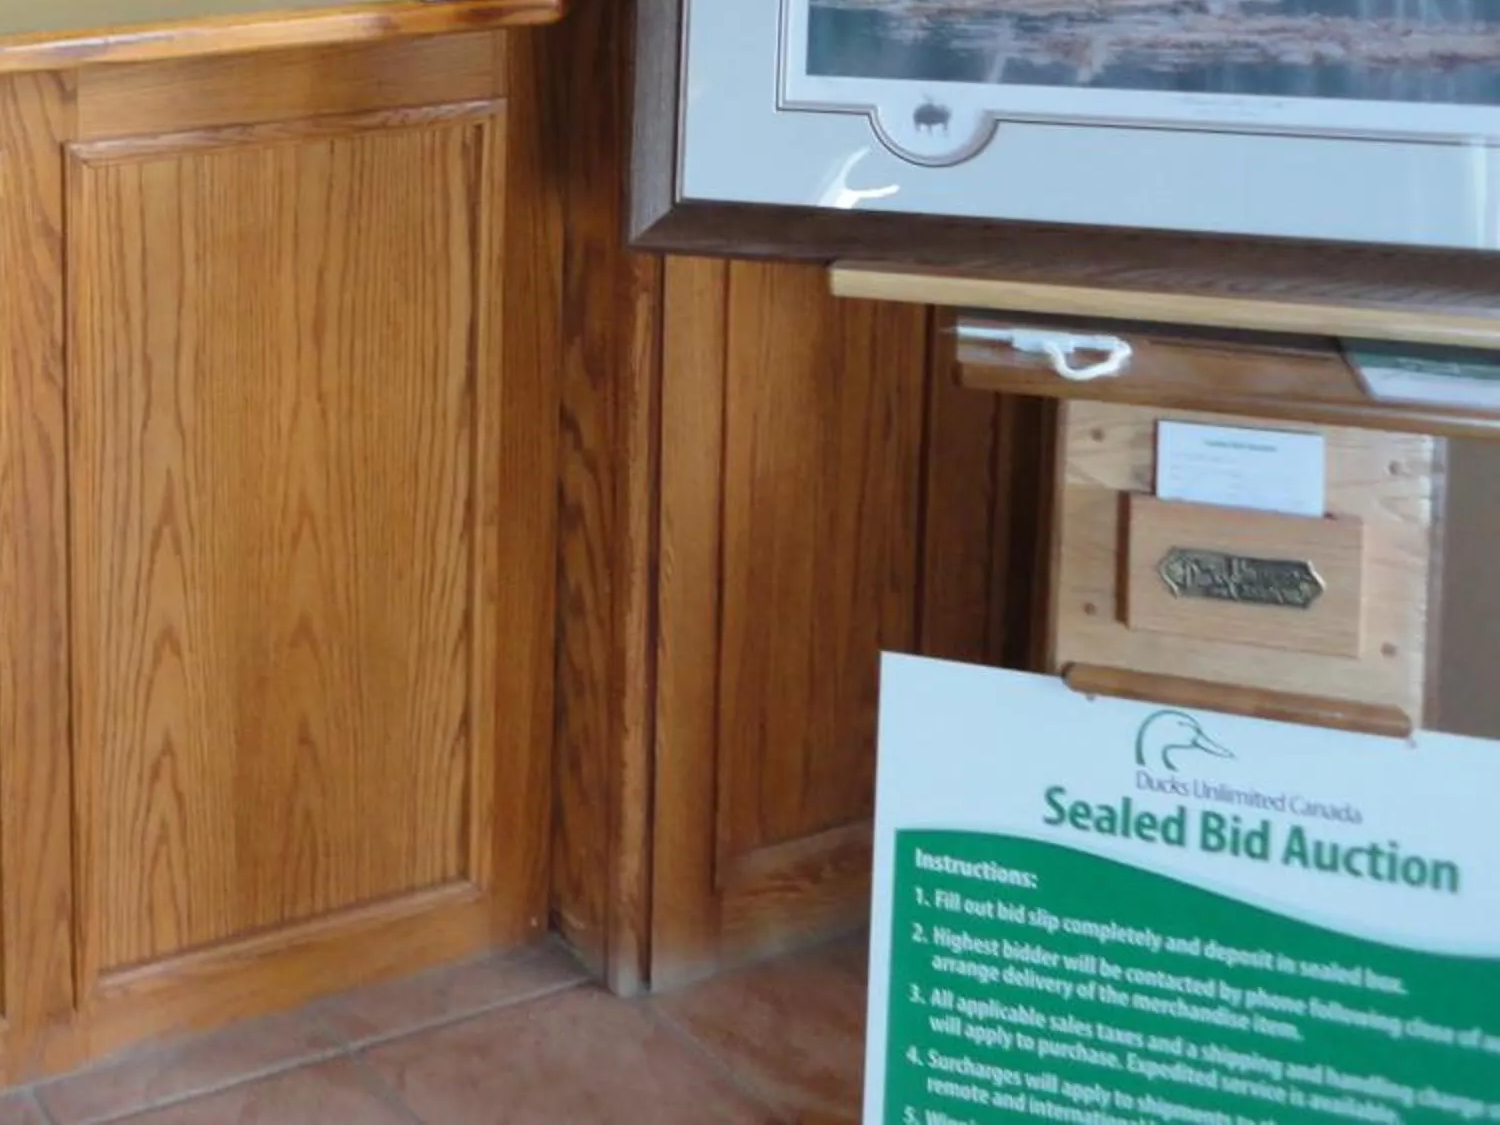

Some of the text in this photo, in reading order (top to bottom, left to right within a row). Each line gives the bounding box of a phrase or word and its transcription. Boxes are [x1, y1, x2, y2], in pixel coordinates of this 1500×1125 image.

[1042, 784, 1461, 894] Sealed Bid Auction
[1136, 770, 1364, 825] Ducks Unlimited Canada
[914, 847, 1039, 889] Instructions:
[915, 887, 931, 908] 1.
[934, 889, 961, 911] Fill
[964, 899, 995, 918] out
[997, 902, 1026, 925] bid
[1028, 908, 1060, 934] slip
[1063, 918, 1163, 952] completely
[1165, 936, 1201, 956] and
[1204, 939, 1274, 970] deposit
[1276, 953, 1296, 974] in
[1300, 961, 1362, 987] sealed
[911, 923, 928, 944] 2.
[932, 925, 1001, 956] Highest
[1002, 939, 1061, 969] bidder
[1063, 953, 1097, 975] will
[1099, 958, 1123, 981] be
[1125, 967, 1216, 998] contacted
[1219, 979, 1244, 1008] by
[1245, 987, 1308, 1015] phone
[1309, 996, 1403, 1040] following
[932, 955, 1000, 984] arrange
[1002, 965, 1074, 1000] delivery
[1076, 980, 1098, 1000] of
[1098, 984, 1130, 1007] the
[1131, 993, 1250, 1031] merchandise
[905, 1045, 924, 1066] 4.
[927, 1048, 1022, 1087] Surcharges
[1023, 1071, 1059, 1094] will
[1060, 1078, 1112, 1108] apply
[1114, 1088, 1135, 1110] to
[908, 982, 927, 1005] 3.
[930, 987, 954, 1010] All
[956, 997, 1047, 1028] applicable
[1049, 1014, 1093, 1038] sales
[1096, 1023, 1145, 1048] taxes
[1147, 1034, 1182, 1055] and
[1185, 1042, 1199, 1060] a
[1201, 1043, 1283, 1080] shipping
[1285, 1062, 1323, 1086] and
[1324, 1063, 1415, 1108] handling
[929, 1015, 961, 1037] will
[963, 1023, 1014, 1050] apply
[1015, 1031, 1036, 1051] to
[1037, 1037, 1124, 1070] purchase.
[1125, 1051, 1218, 1090] Expedited
[1221, 1076, 1287, 1105] service
[1289, 1082, 1306, 1107] is
[927, 1076, 990, 1104] remote
[991, 1091, 1027, 1113] and
